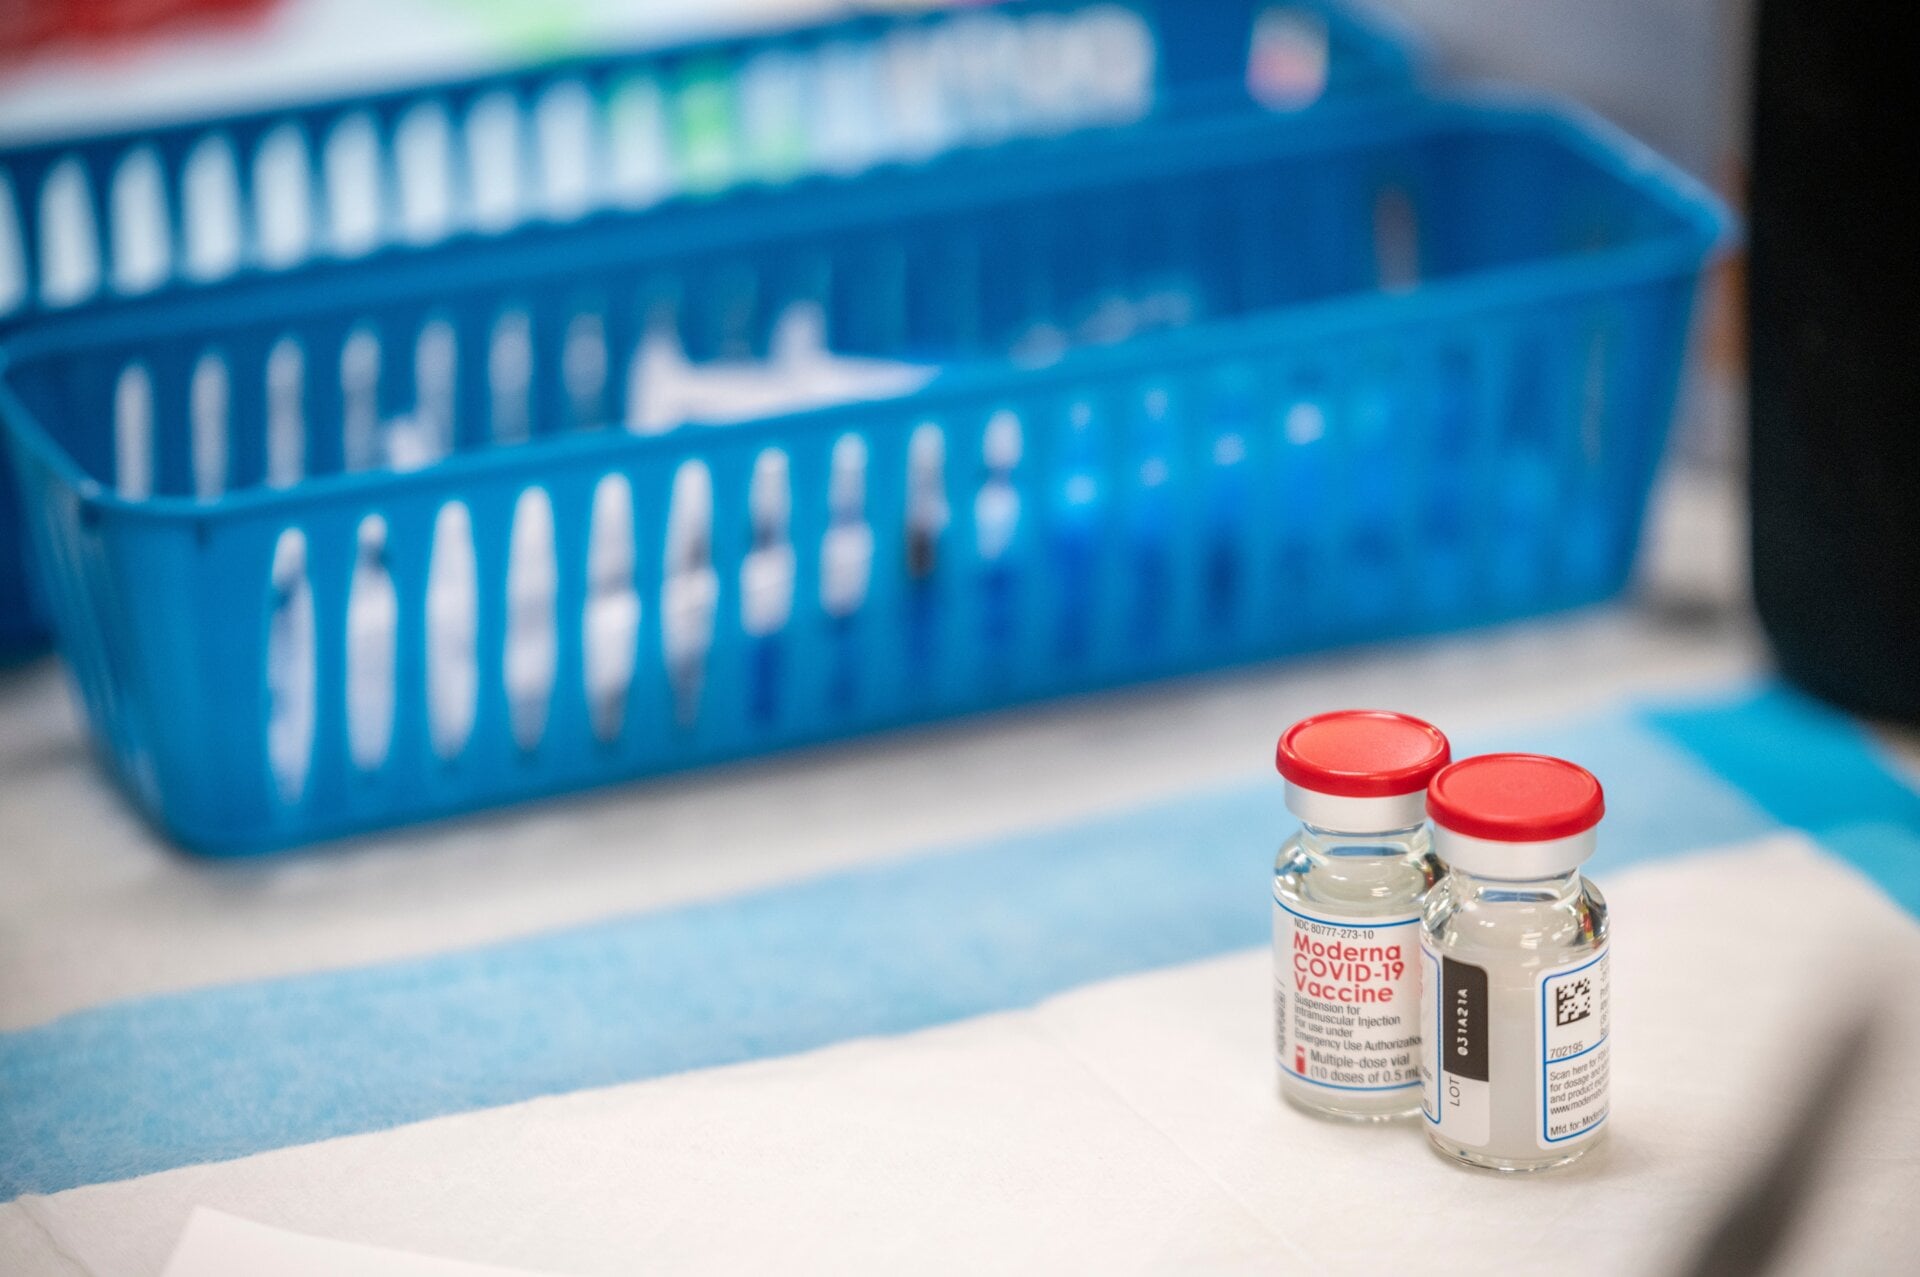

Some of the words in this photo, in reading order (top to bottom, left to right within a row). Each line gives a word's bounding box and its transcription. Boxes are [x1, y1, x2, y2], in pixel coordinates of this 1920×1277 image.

[1294, 917, 1309, 931] NDC
[1311, 923, 1374, 940] 80777-273-10
[1293, 931, 1402, 962] Moderna
[1293, 953, 1405, 982] COVID-19
[1293, 971, 1394, 1003] Vaccine
[1294, 992, 1344, 1015] Suspension
[1346, 1005, 1361, 1015] for
[1294, 1006, 1355, 1026] Intramuscular
[1358, 1015, 1401, 1029] Injection
[1294, 1015, 1306, 1028] For
[1308, 1023, 1324, 1034] use
[1325, 1026, 1353, 1038] under
[1456, 988, 1469, 1056] 031A21A
[1294, 1028, 1341, 1050] Emergency
[1343, 1040, 1362, 1051] Use
[1364, 1035, 1422, 1051] Authorizatio
[1550, 1041, 1584, 1059] 702195
[1310, 1049, 1388, 1069] Multiple-dose
[1390, 1053, 1410, 1067] vial
[1310, 1065, 1328, 1080] (10
[1330, 1070, 1365, 1084] doses
[1367, 1068, 1380, 1083] of
[1382, 1069, 1402, 1083] 0.5
[1404, 1066, 1421, 1079] mL
[1549, 1070, 1571, 1081] Scan
[1572, 1063, 1588, 1075] here
[1549, 1083, 1562, 1093] for
[1563, 1074, 1590, 1090] dosage
[1449, 1077, 1461, 1107] LOT
[1549, 1093, 1566, 1104] and
[1567, 1083, 1594, 1102] product
